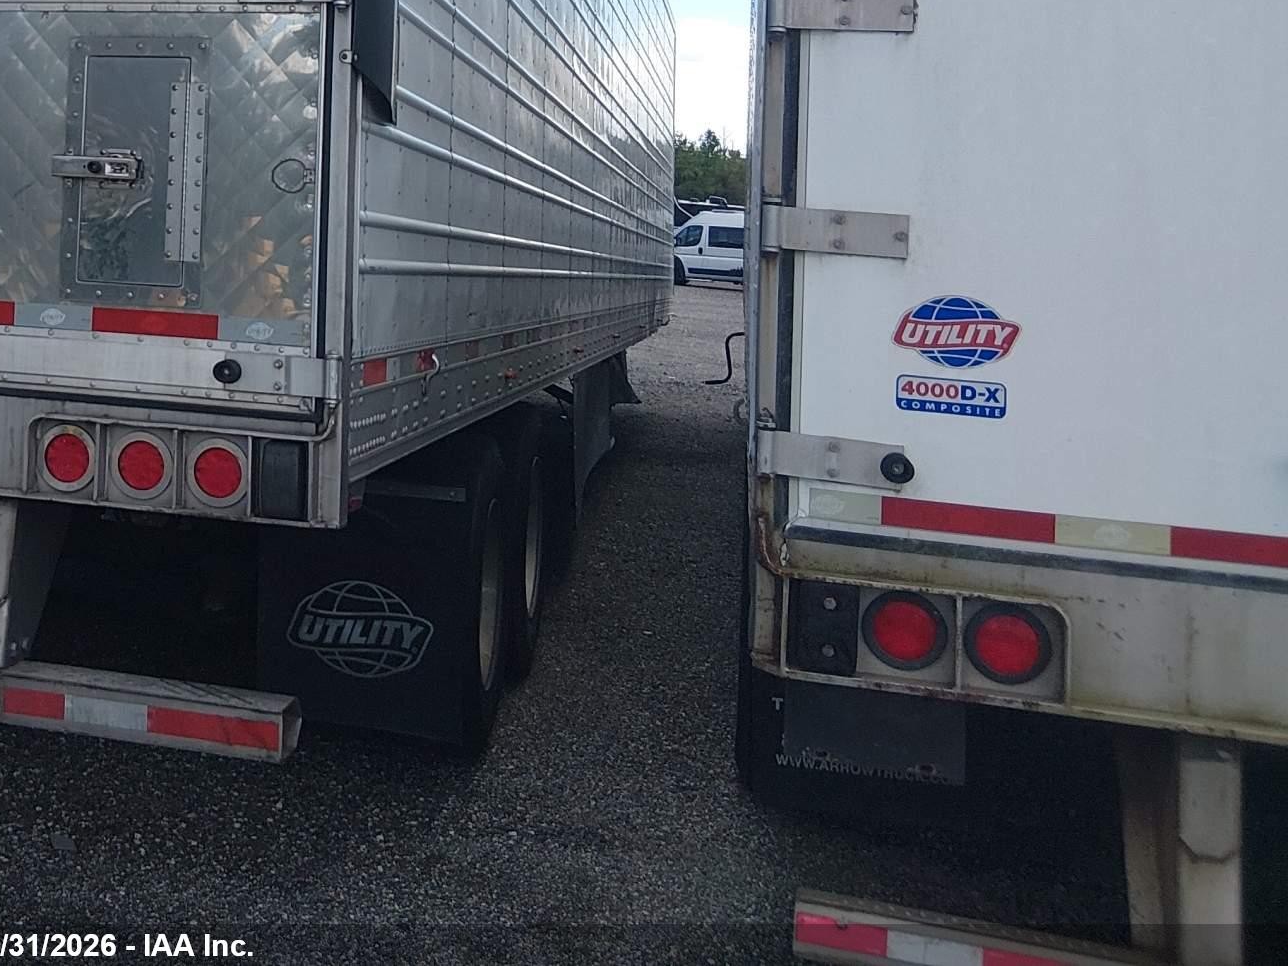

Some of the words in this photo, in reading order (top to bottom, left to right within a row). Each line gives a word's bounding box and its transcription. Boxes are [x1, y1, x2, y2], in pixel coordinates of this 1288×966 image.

[901, 322, 1014, 346] UTILITY
[901, 380, 1001, 404] 4000D-X
[900, 400, 1001, 417] COMPOSITE
[298, 614, 425, 649] UTILITY
